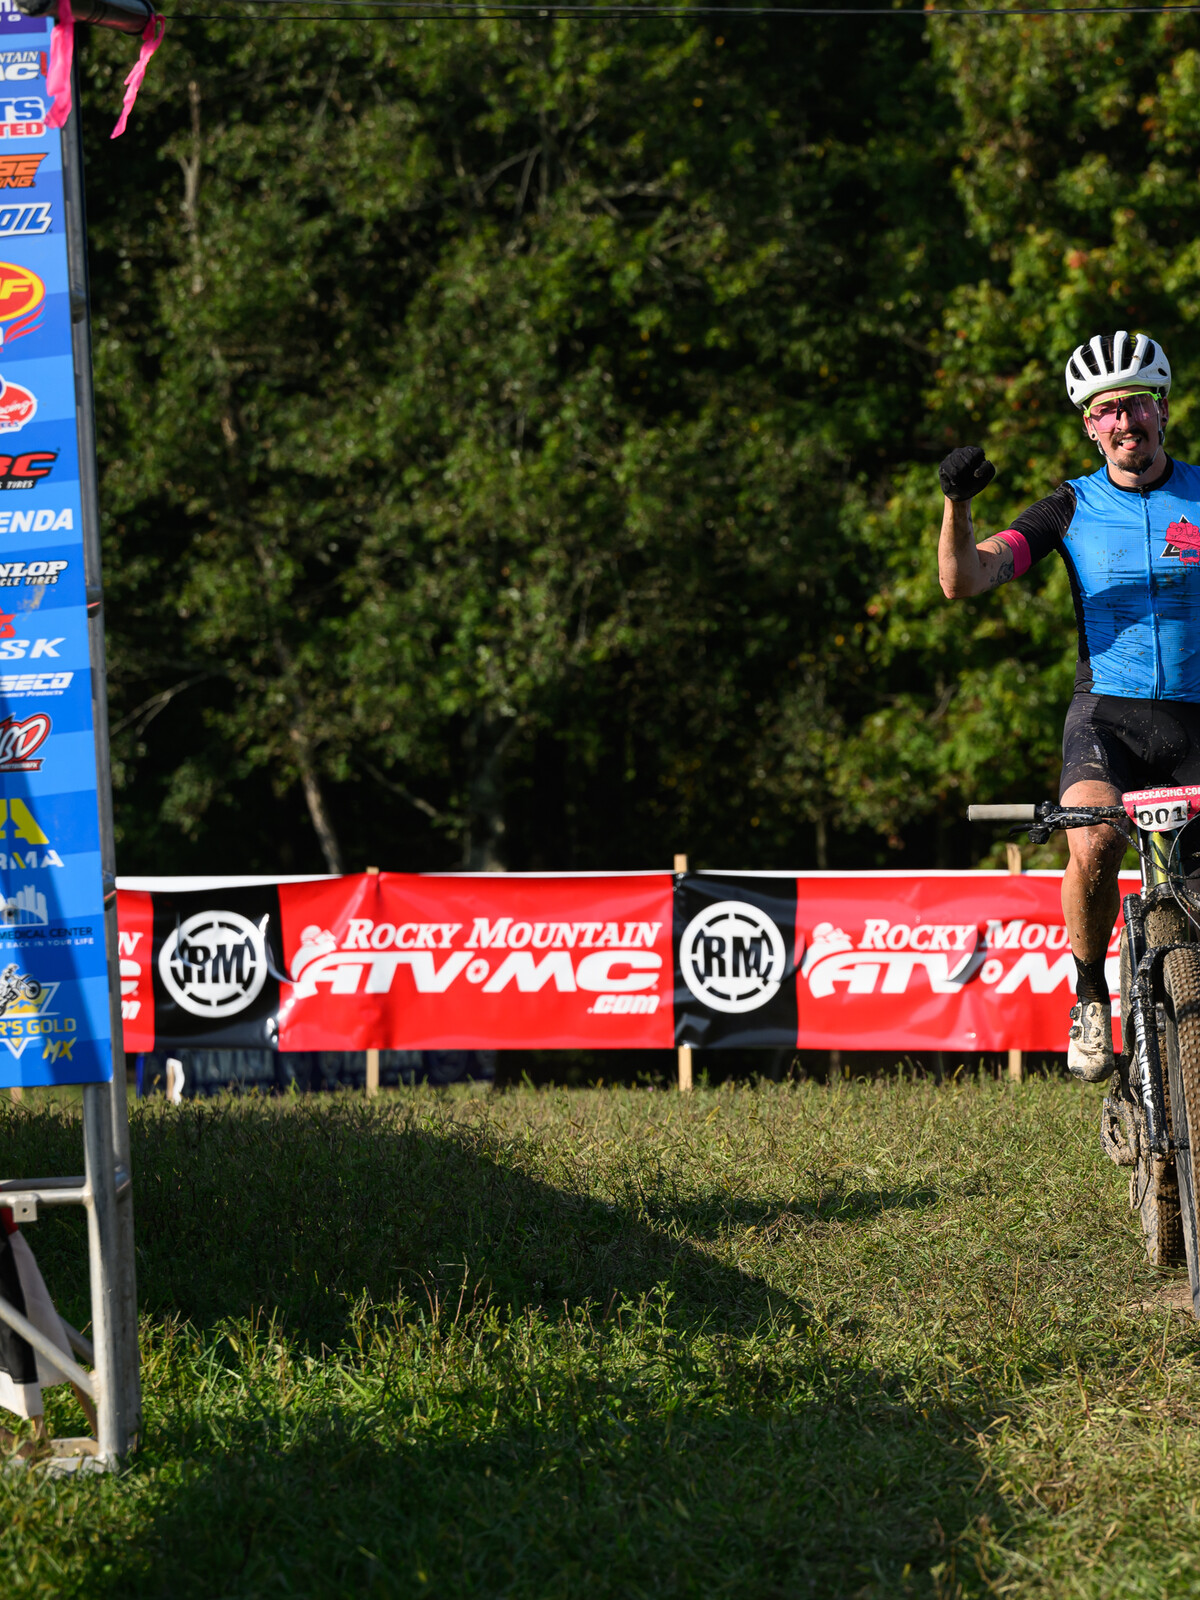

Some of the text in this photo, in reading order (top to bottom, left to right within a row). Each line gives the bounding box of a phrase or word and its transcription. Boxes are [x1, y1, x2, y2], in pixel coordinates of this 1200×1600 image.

[25, 575, 59, 586] TIRES
[1138, 805, 1187, 826] 001
[49, 926, 93, 938] CENTER
[74, 937, 94, 946] LIFE
[341, 917, 662, 949] ROCKY MOUNTAIN
[858, 919, 978, 951] ROCKY
[703, 936, 763, 978] RM
[26, 1017, 77, 1035] GOLD
[42, 1036, 78, 1064] MX
